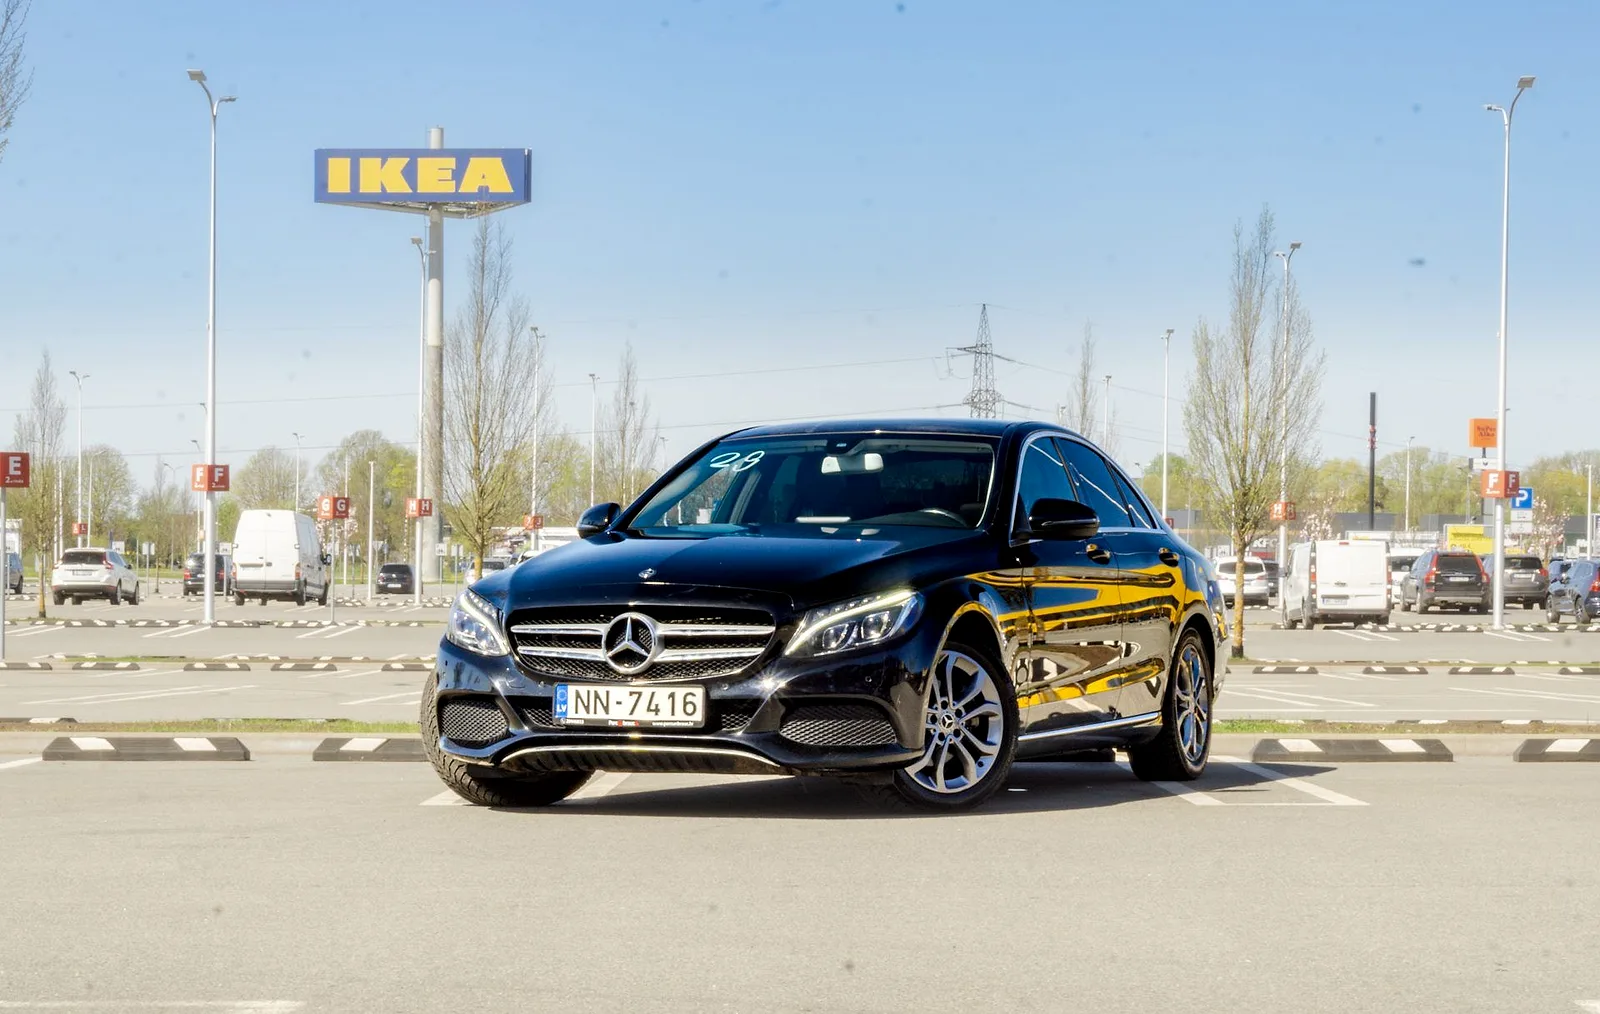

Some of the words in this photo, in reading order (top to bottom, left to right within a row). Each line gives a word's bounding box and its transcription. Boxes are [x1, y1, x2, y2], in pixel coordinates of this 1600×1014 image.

[328, 157, 514, 193] IKEA
[9, 456, 21, 475] E
[710, 450, 765, 471] 29
[196, 467, 204, 482] F
[214, 467, 224, 482] F
[1489, 473, 1498, 488] F
[1509, 474, 1516, 488] F
[322, 499, 331, 512] G
[336, 499, 346, 512] G
[410, 500, 416, 510] H
[422, 500, 429, 510] H
[1515, 490, 1528, 506] P
[557, 704, 567, 712] LV
[574, 689, 697, 717] NN-7416
